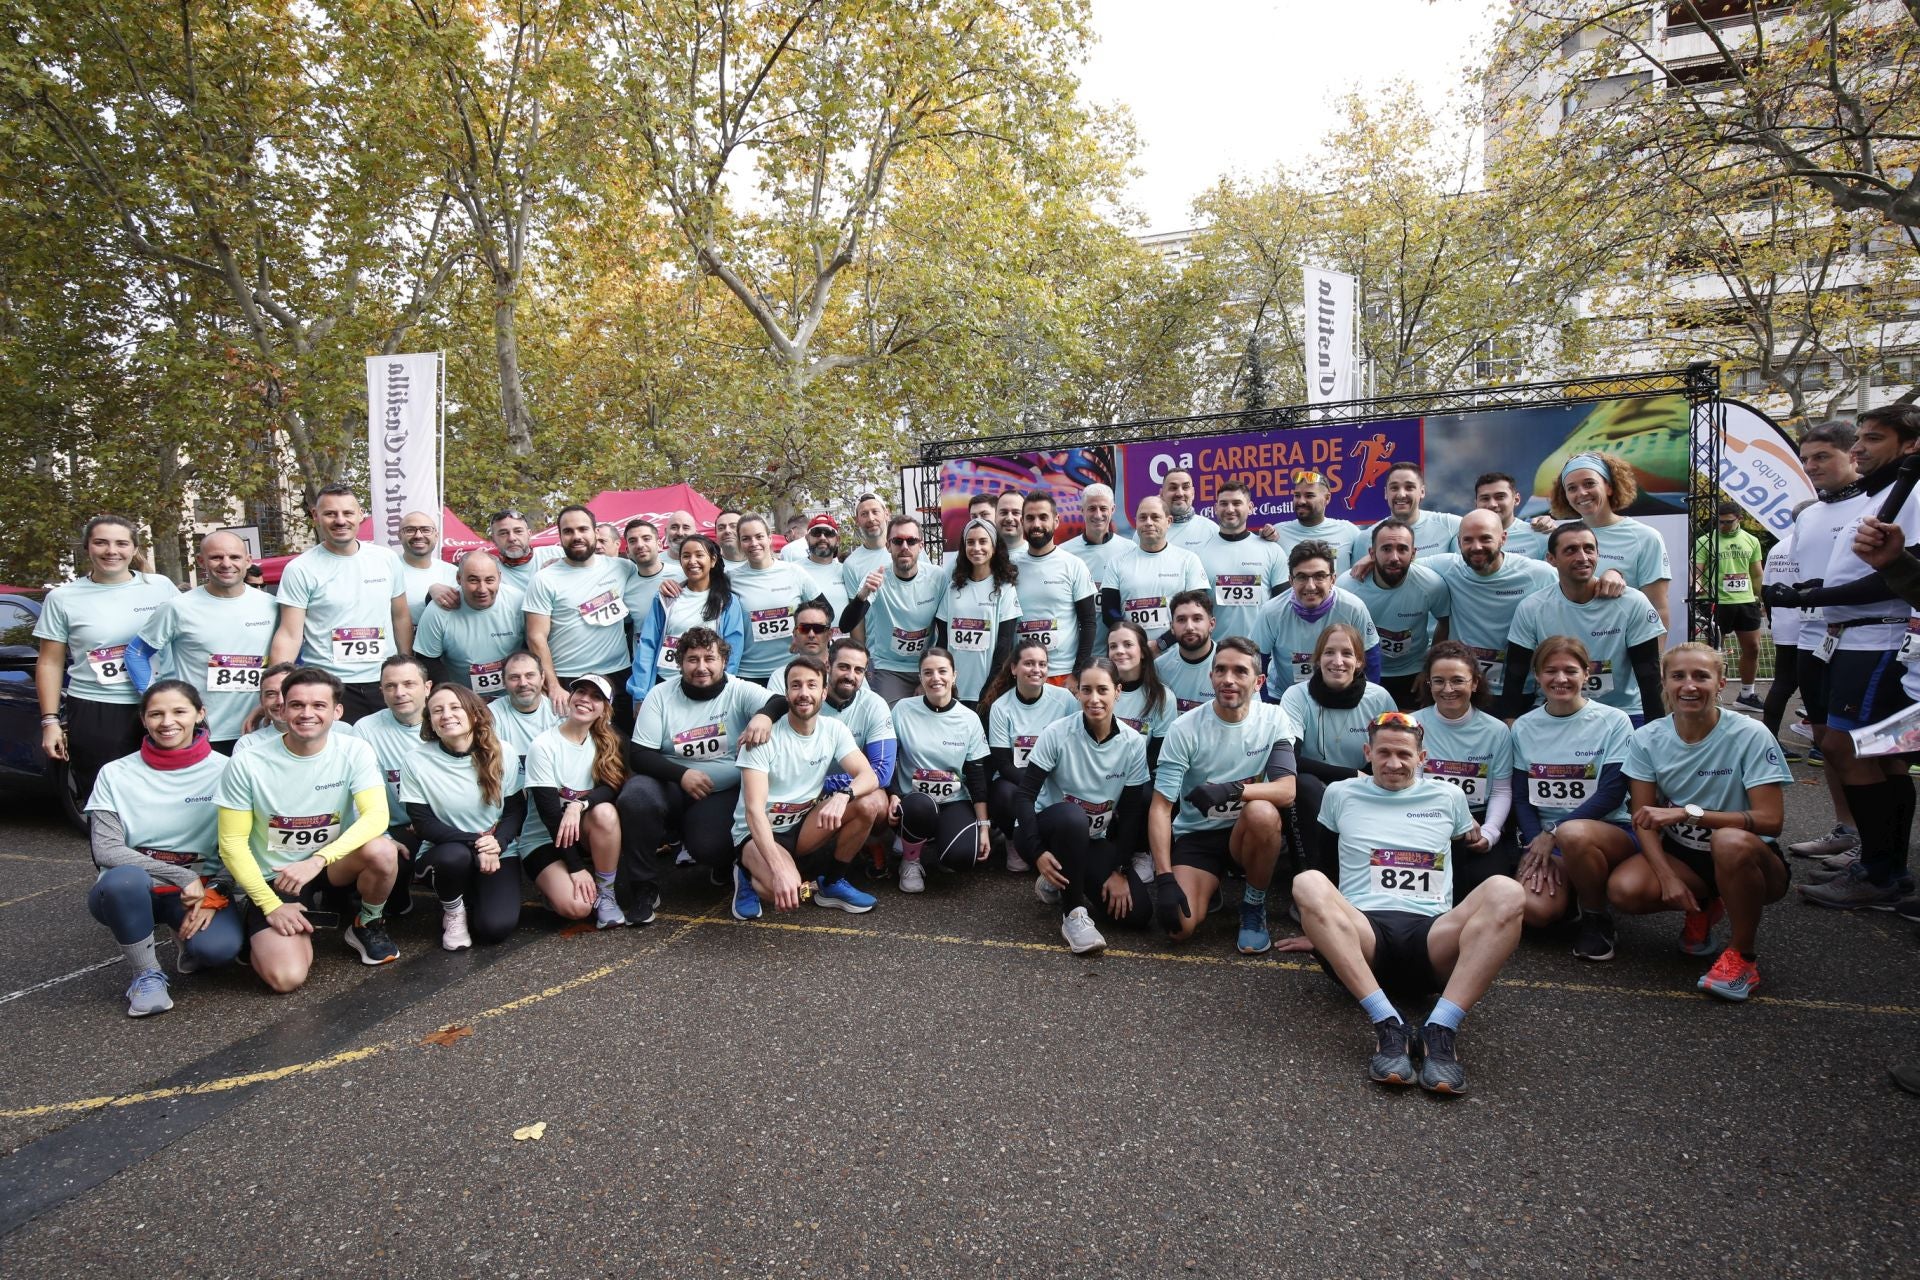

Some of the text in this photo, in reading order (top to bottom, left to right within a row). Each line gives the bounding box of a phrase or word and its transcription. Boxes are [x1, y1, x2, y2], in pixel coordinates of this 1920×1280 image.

[1199, 438, 1343, 472] CARRERA DE
[1259, 501, 1295, 516] Castil
[1727, 580, 1746, 588] 439
[1222, 587, 1254, 600] 793
[590, 602, 621, 622] 778
[1131, 609, 1159, 623] 801
[758, 619, 789, 635] 852
[955, 630, 984, 645] 847
[341, 641, 380, 656] 795
[897, 639, 925, 652] 785
[1381, 639, 1404, 653] 28
[216, 669, 260, 687] 849
[478, 673, 502, 688] 83
[682, 738, 720, 757] 810
[918, 782, 953, 797] 846
[1537, 780, 1586, 800] 838
[1406, 811, 1442, 819] OneHealth
[278, 828, 329, 846] 796
[1380, 868, 1430, 892] 821
